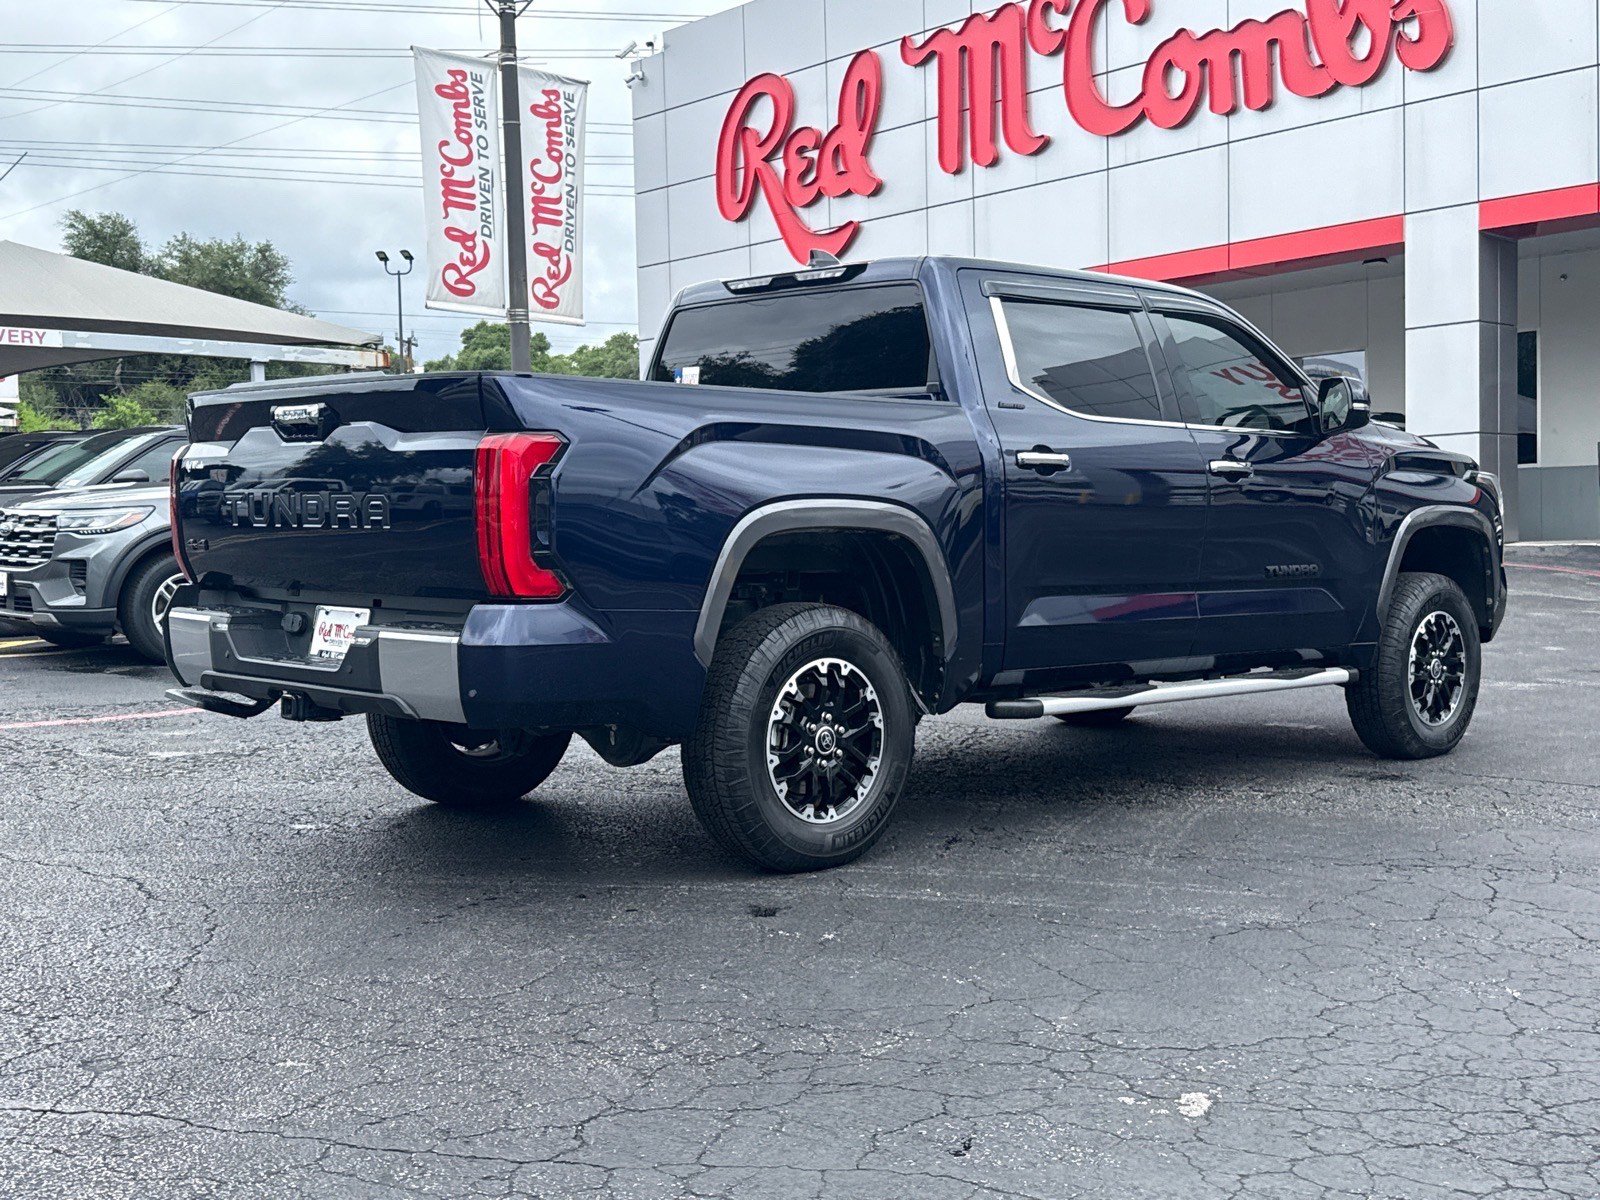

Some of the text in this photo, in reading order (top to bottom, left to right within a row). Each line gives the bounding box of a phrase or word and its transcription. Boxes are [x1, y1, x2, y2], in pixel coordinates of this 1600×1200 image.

[434, 69, 491, 297] Red McCombs
[470, 71, 493, 239] DRIVEN TO SERVE
[529, 89, 572, 310] Red McCombs
[563, 91, 576, 253] DRIVEN TO SERVE
[716, 0, 1456, 266] Red McCombs
[225, 492, 391, 529] TUNDRA
[1264, 564, 1321, 577] TUNDRA
[771, 632, 835, 684] MICHELIN
[834, 793, 893, 848] MICHELIN
